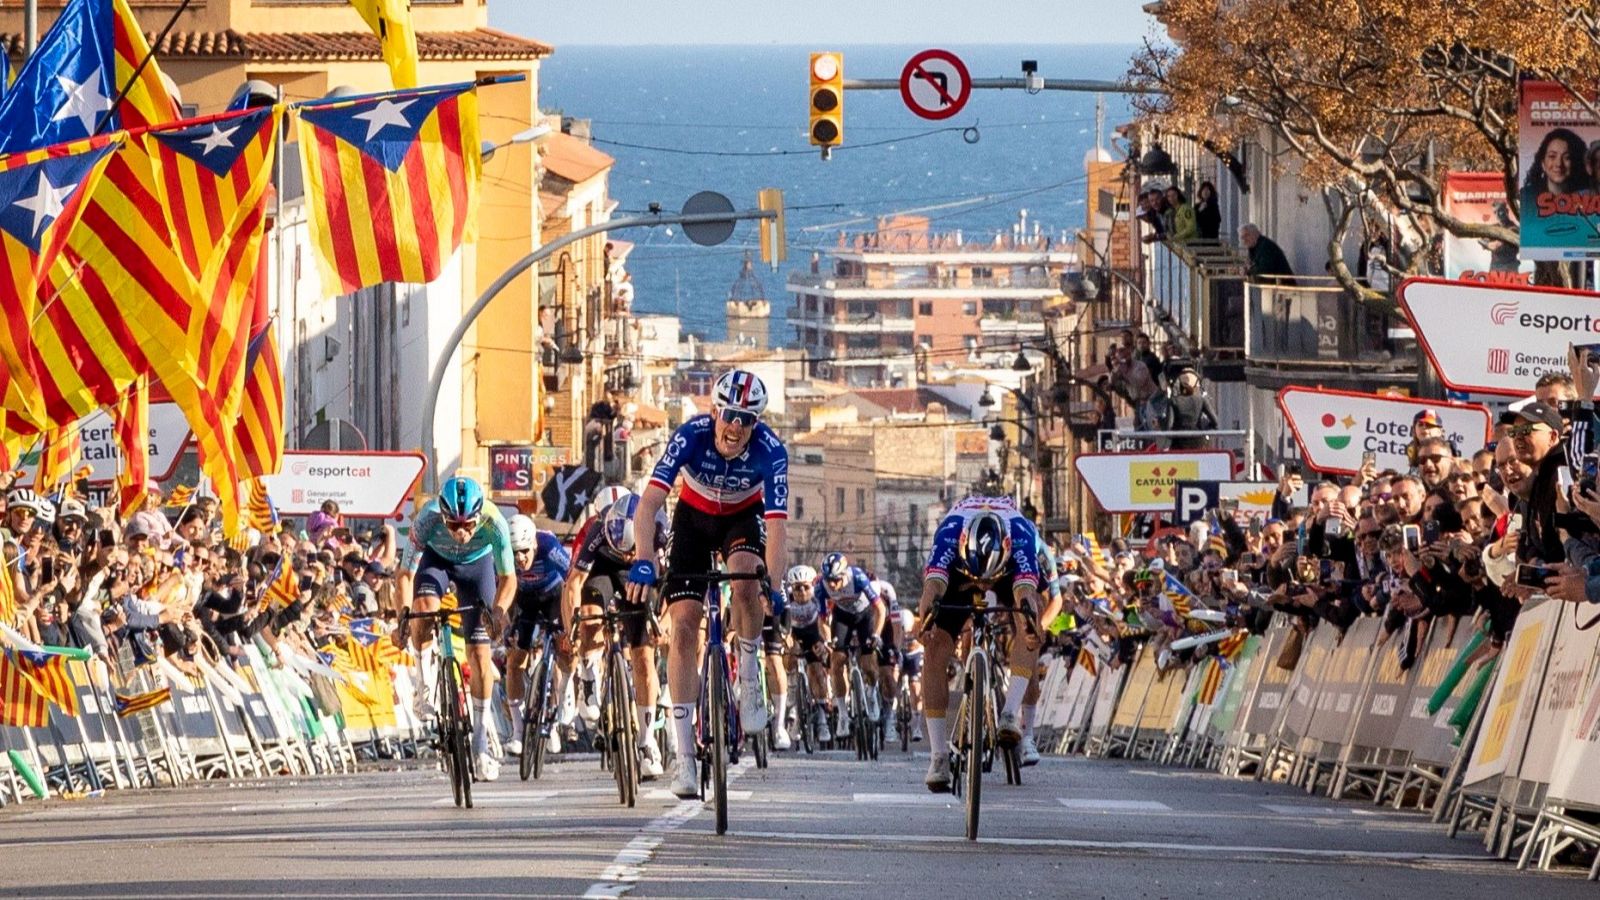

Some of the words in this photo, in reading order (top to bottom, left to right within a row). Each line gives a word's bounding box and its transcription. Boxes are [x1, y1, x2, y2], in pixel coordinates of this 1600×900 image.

[1515, 352, 1569, 367] Generali
[1514, 365, 1529, 376] de
[1448, 431, 1464, 443] de
[495, 453, 567, 465] PINTORES
[309, 464, 371, 478] esportcat
[695, 472, 751, 489] INEOS
[1181, 487, 1208, 522] P
[1013, 549, 1033, 573] BOSS
